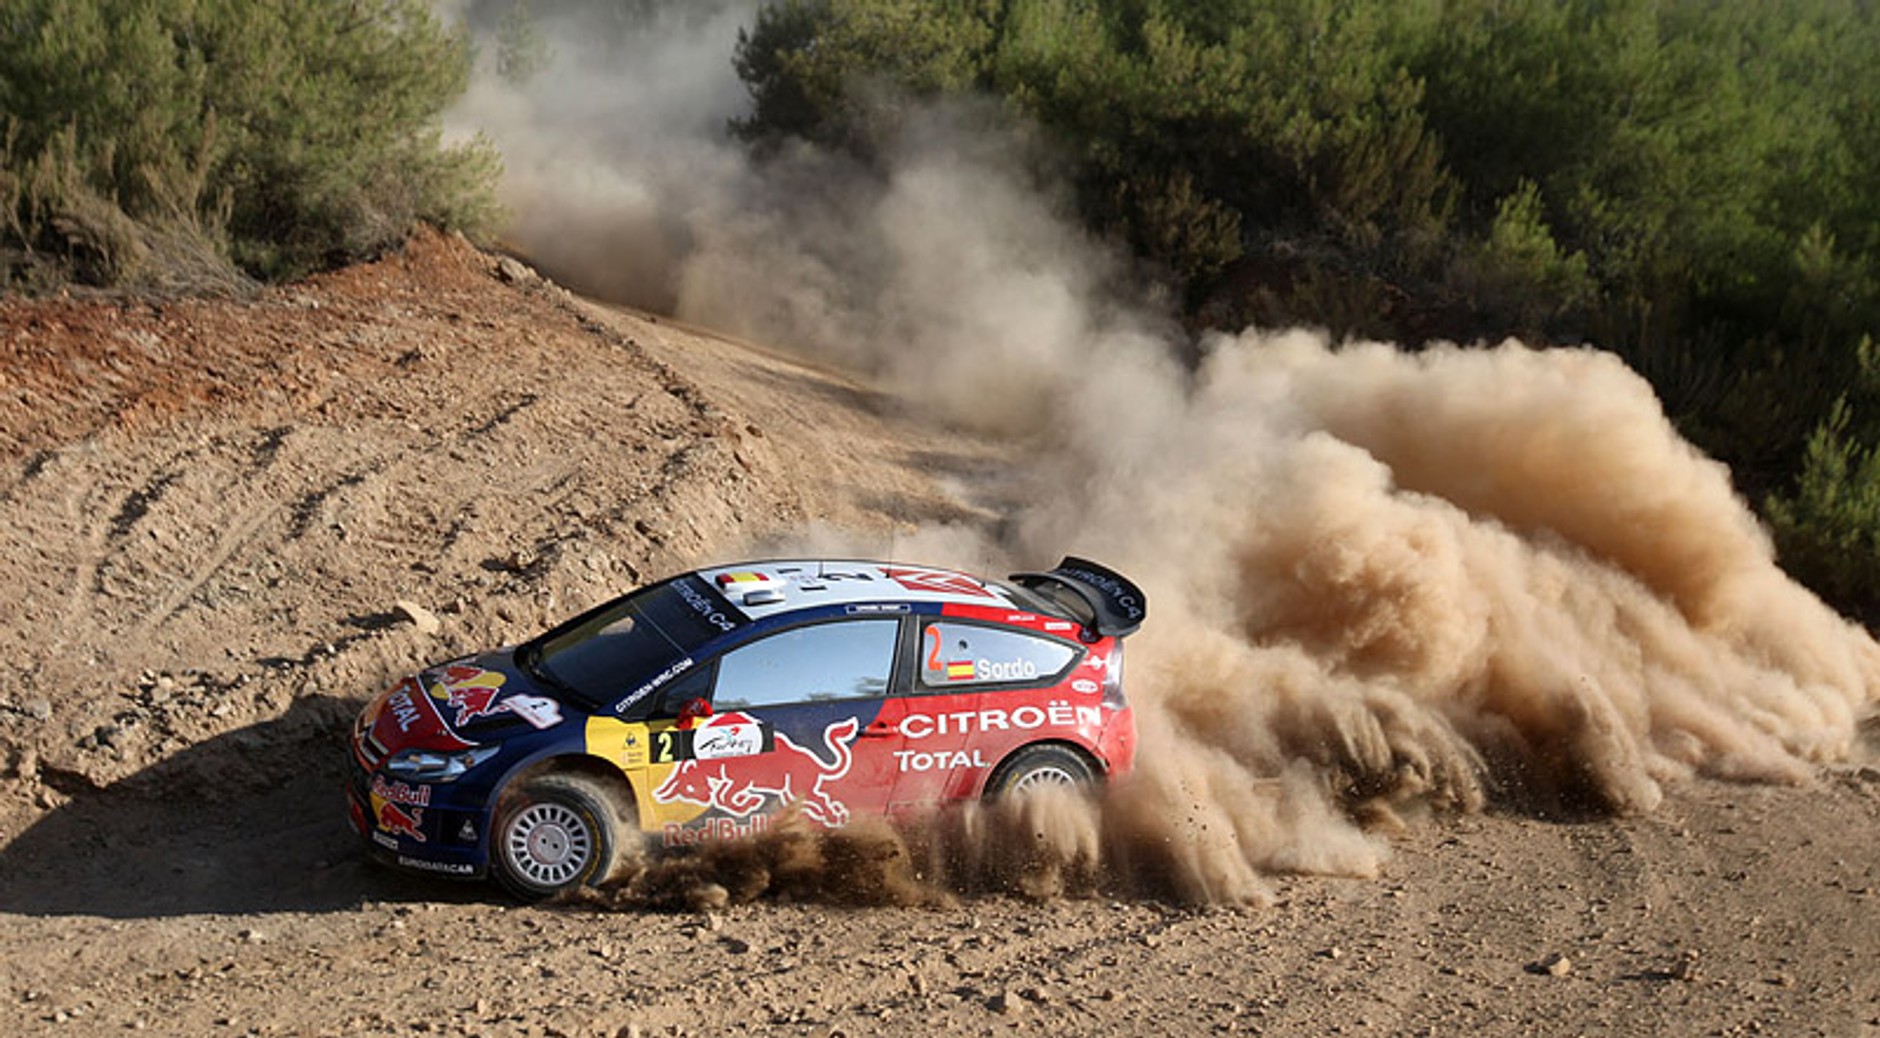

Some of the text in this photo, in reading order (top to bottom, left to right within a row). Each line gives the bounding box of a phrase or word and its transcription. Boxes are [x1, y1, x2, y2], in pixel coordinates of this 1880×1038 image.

[925, 625, 943, 671] 2
[977, 658, 1036, 679] Sordo
[899, 701, 1101, 739] CITROËN
[657, 732, 674, 763] 2
[663, 814, 767, 847] Red Bull
